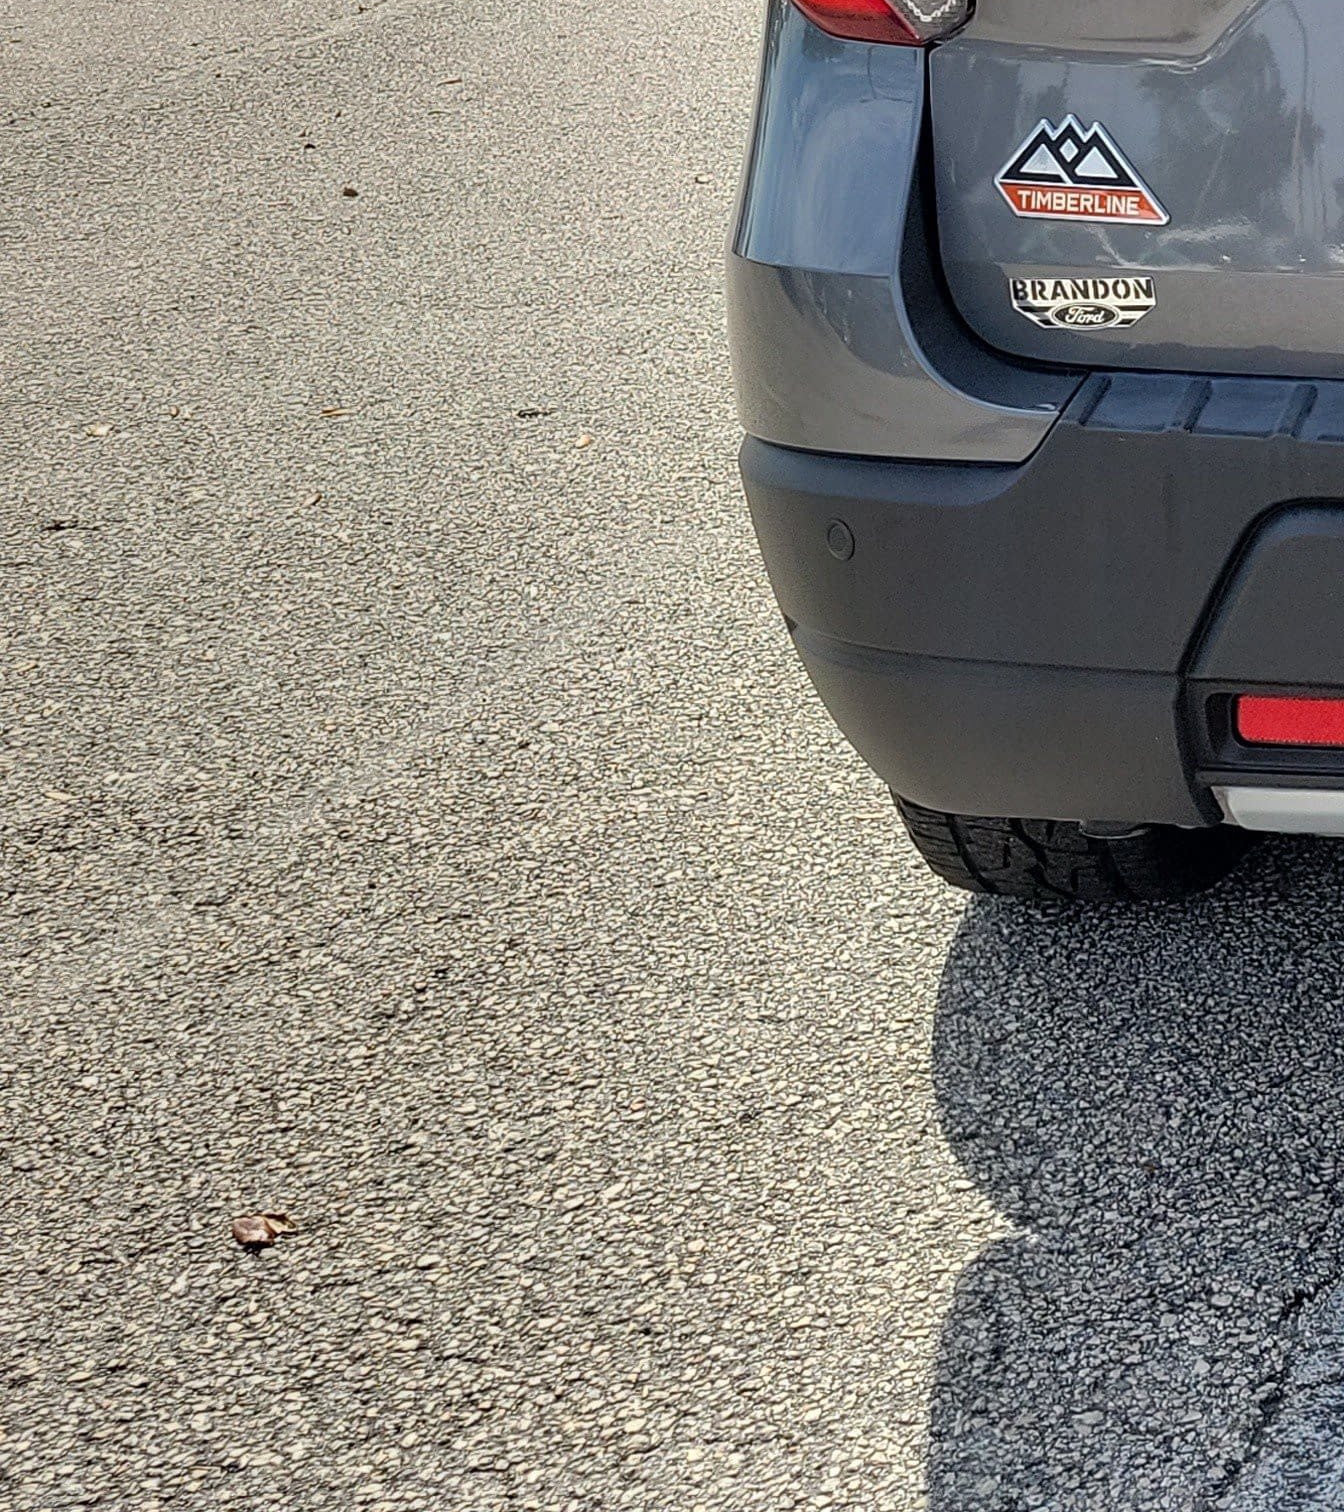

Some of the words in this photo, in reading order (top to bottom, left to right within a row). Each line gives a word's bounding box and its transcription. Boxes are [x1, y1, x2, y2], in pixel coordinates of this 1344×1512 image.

[1017, 190, 1141, 216] TIMBERLINE
[1012, 278, 1153, 301] BRANDON
[1064, 305, 1106, 324] Ford
